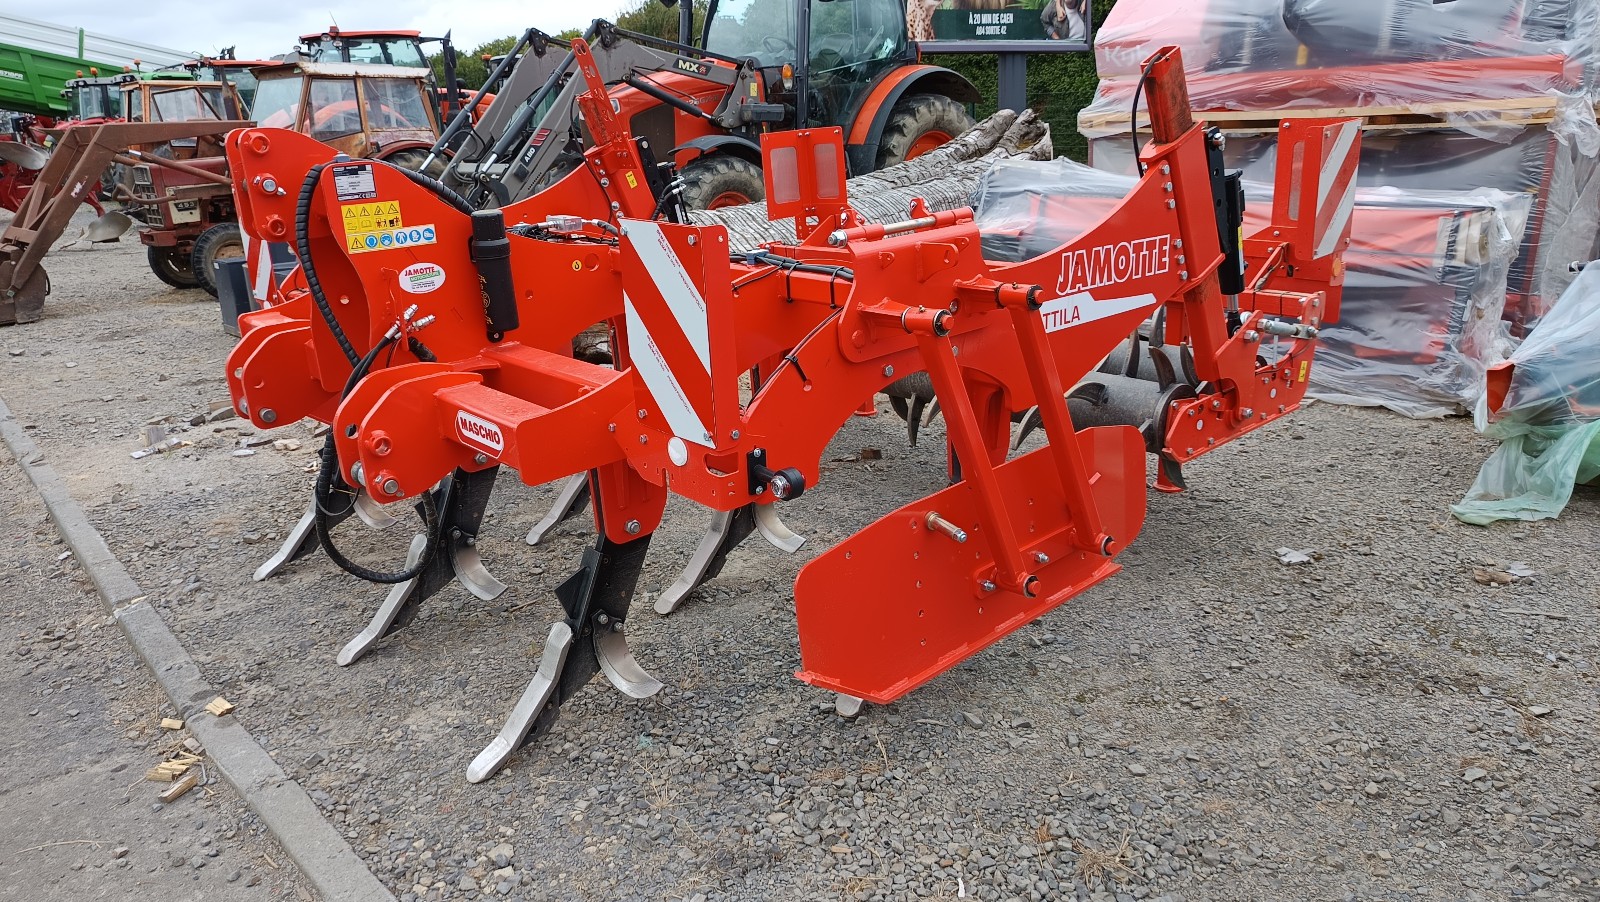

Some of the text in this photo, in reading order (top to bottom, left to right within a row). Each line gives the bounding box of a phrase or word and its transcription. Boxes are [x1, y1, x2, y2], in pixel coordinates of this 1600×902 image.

[968, 11, 1013, 24] À 20 MIN DE CAEN
[986, 26, 1000, 35] SORTIE
[1001, 26, 1007, 35] 42
[678, 60, 699, 72] MX
[1055, 234, 1170, 296] JAMOTTE
[404, 267, 435, 277] JAMOTTE
[1043, 305, 1081, 330] TTILA
[460, 416, 501, 446] MASCHIO
